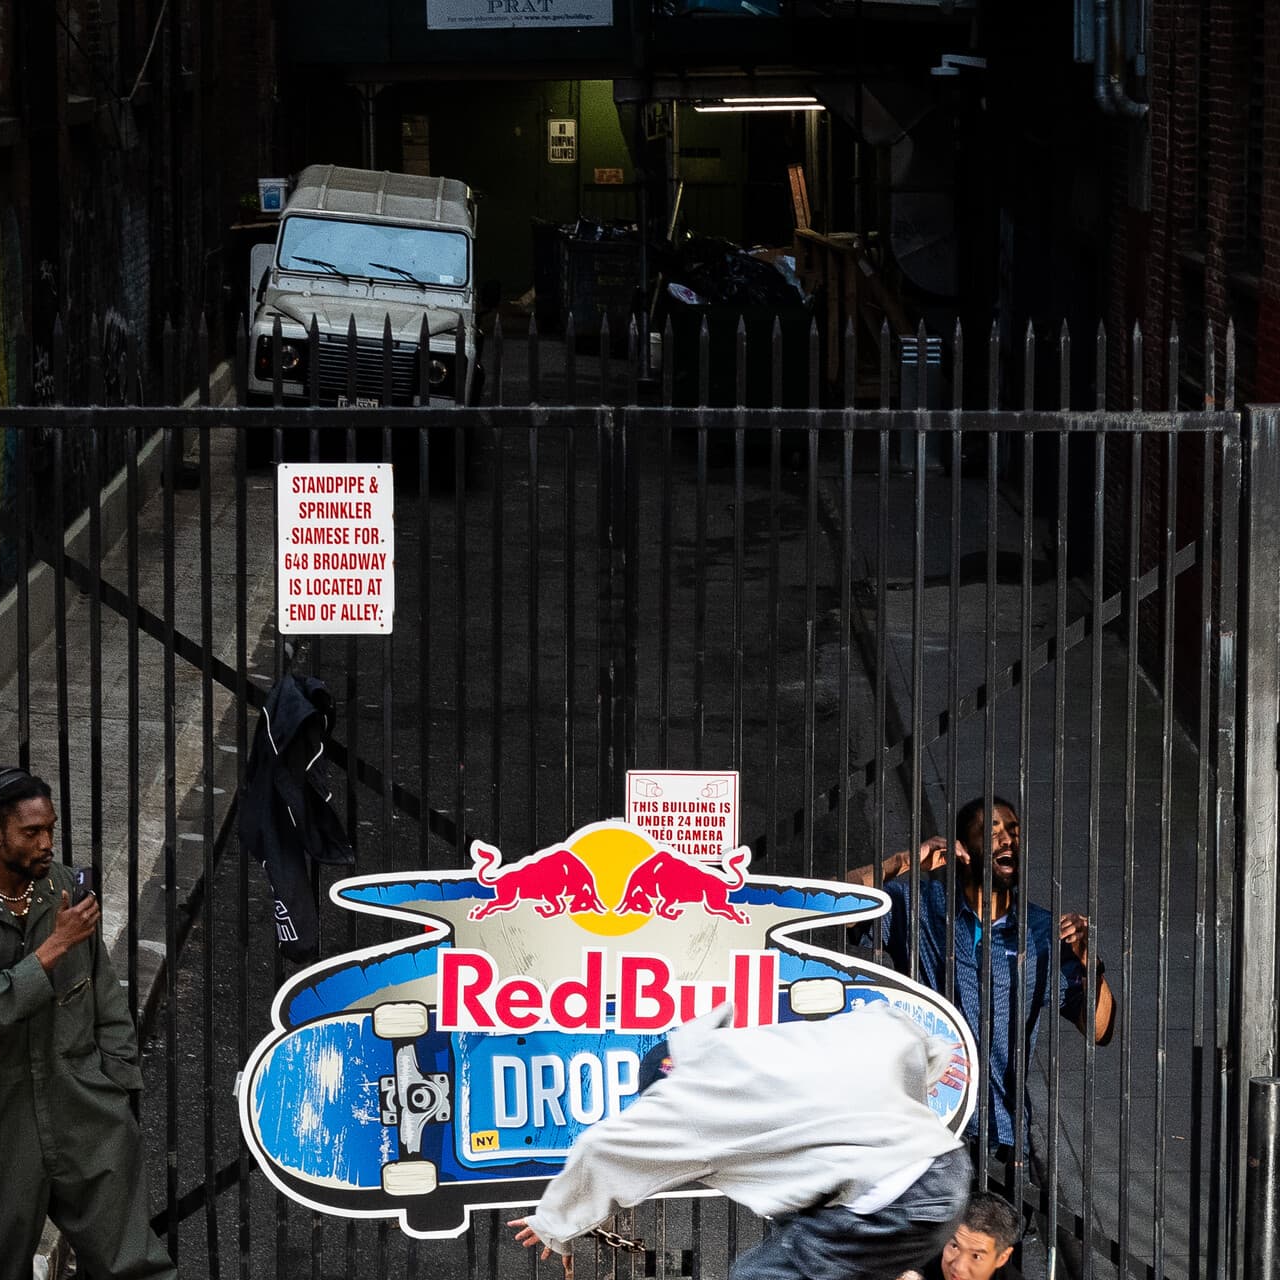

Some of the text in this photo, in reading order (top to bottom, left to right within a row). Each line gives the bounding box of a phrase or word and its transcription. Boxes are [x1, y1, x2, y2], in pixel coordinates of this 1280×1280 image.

[292, 476, 379, 494] STANDPIPE &
[298, 501, 372, 519] SPRINKLER
[291, 527, 380, 545] SIAMESE FOR
[284, 552, 387, 570] 648 BROADWAY
[289, 578, 383, 596] IS LOCATED AT
[289, 604, 316, 621] END
[320, 604, 337, 621] OF
[632, 801, 731, 813] THIS BUILDING IS
[637, 815, 726, 827] UNDER 24 HOUR
[644, 828, 723, 841] DEO CAMERA
[441, 950, 776, 1030] Red Bull
[491, 1050, 640, 1130] DROP
[476, 1135, 494, 1147] NY
